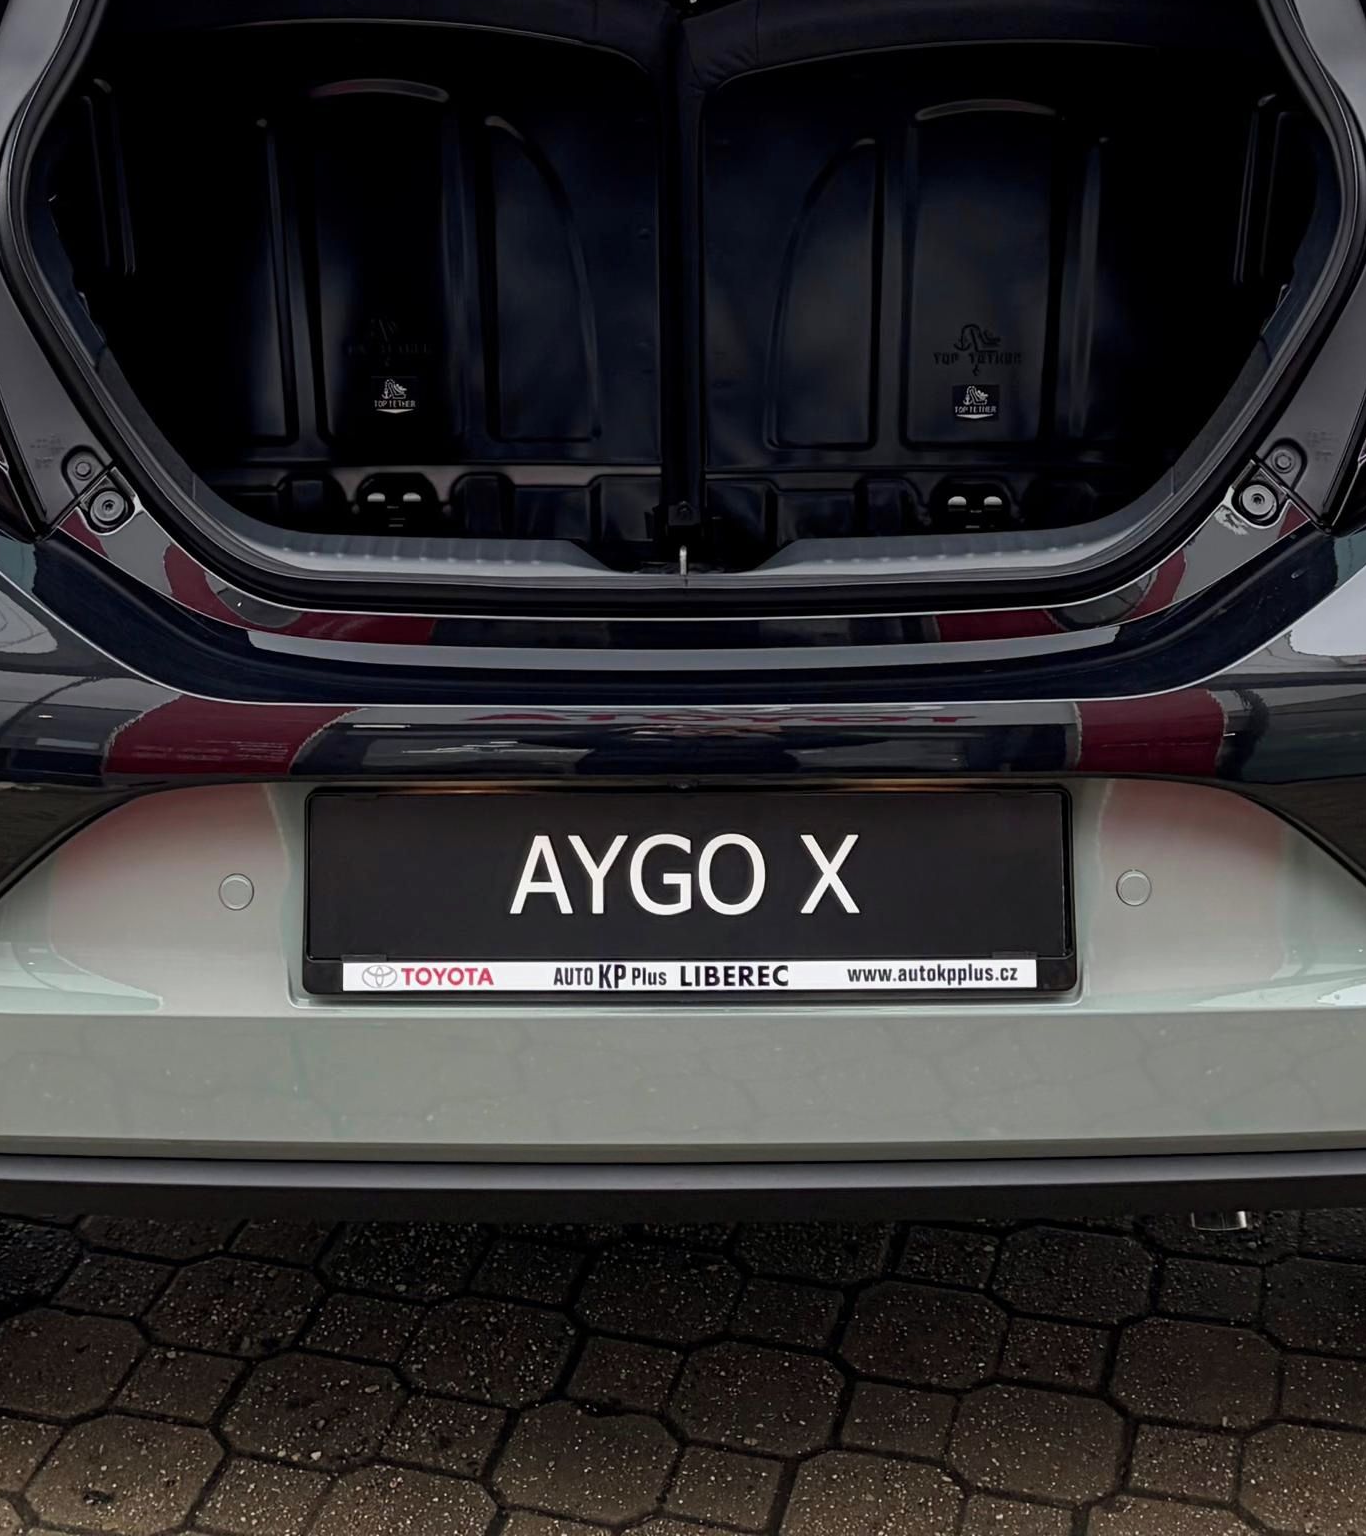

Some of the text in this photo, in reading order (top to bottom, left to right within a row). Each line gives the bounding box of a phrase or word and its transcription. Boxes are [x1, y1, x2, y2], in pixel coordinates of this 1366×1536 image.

[509, 833, 860, 916] AYGO X
[401, 967, 494, 986] TOYOTA
[553, 964, 789, 989] AUTO KP Plus LIBEREC
[847, 964, 1018, 985] www.autokpplus.cz
